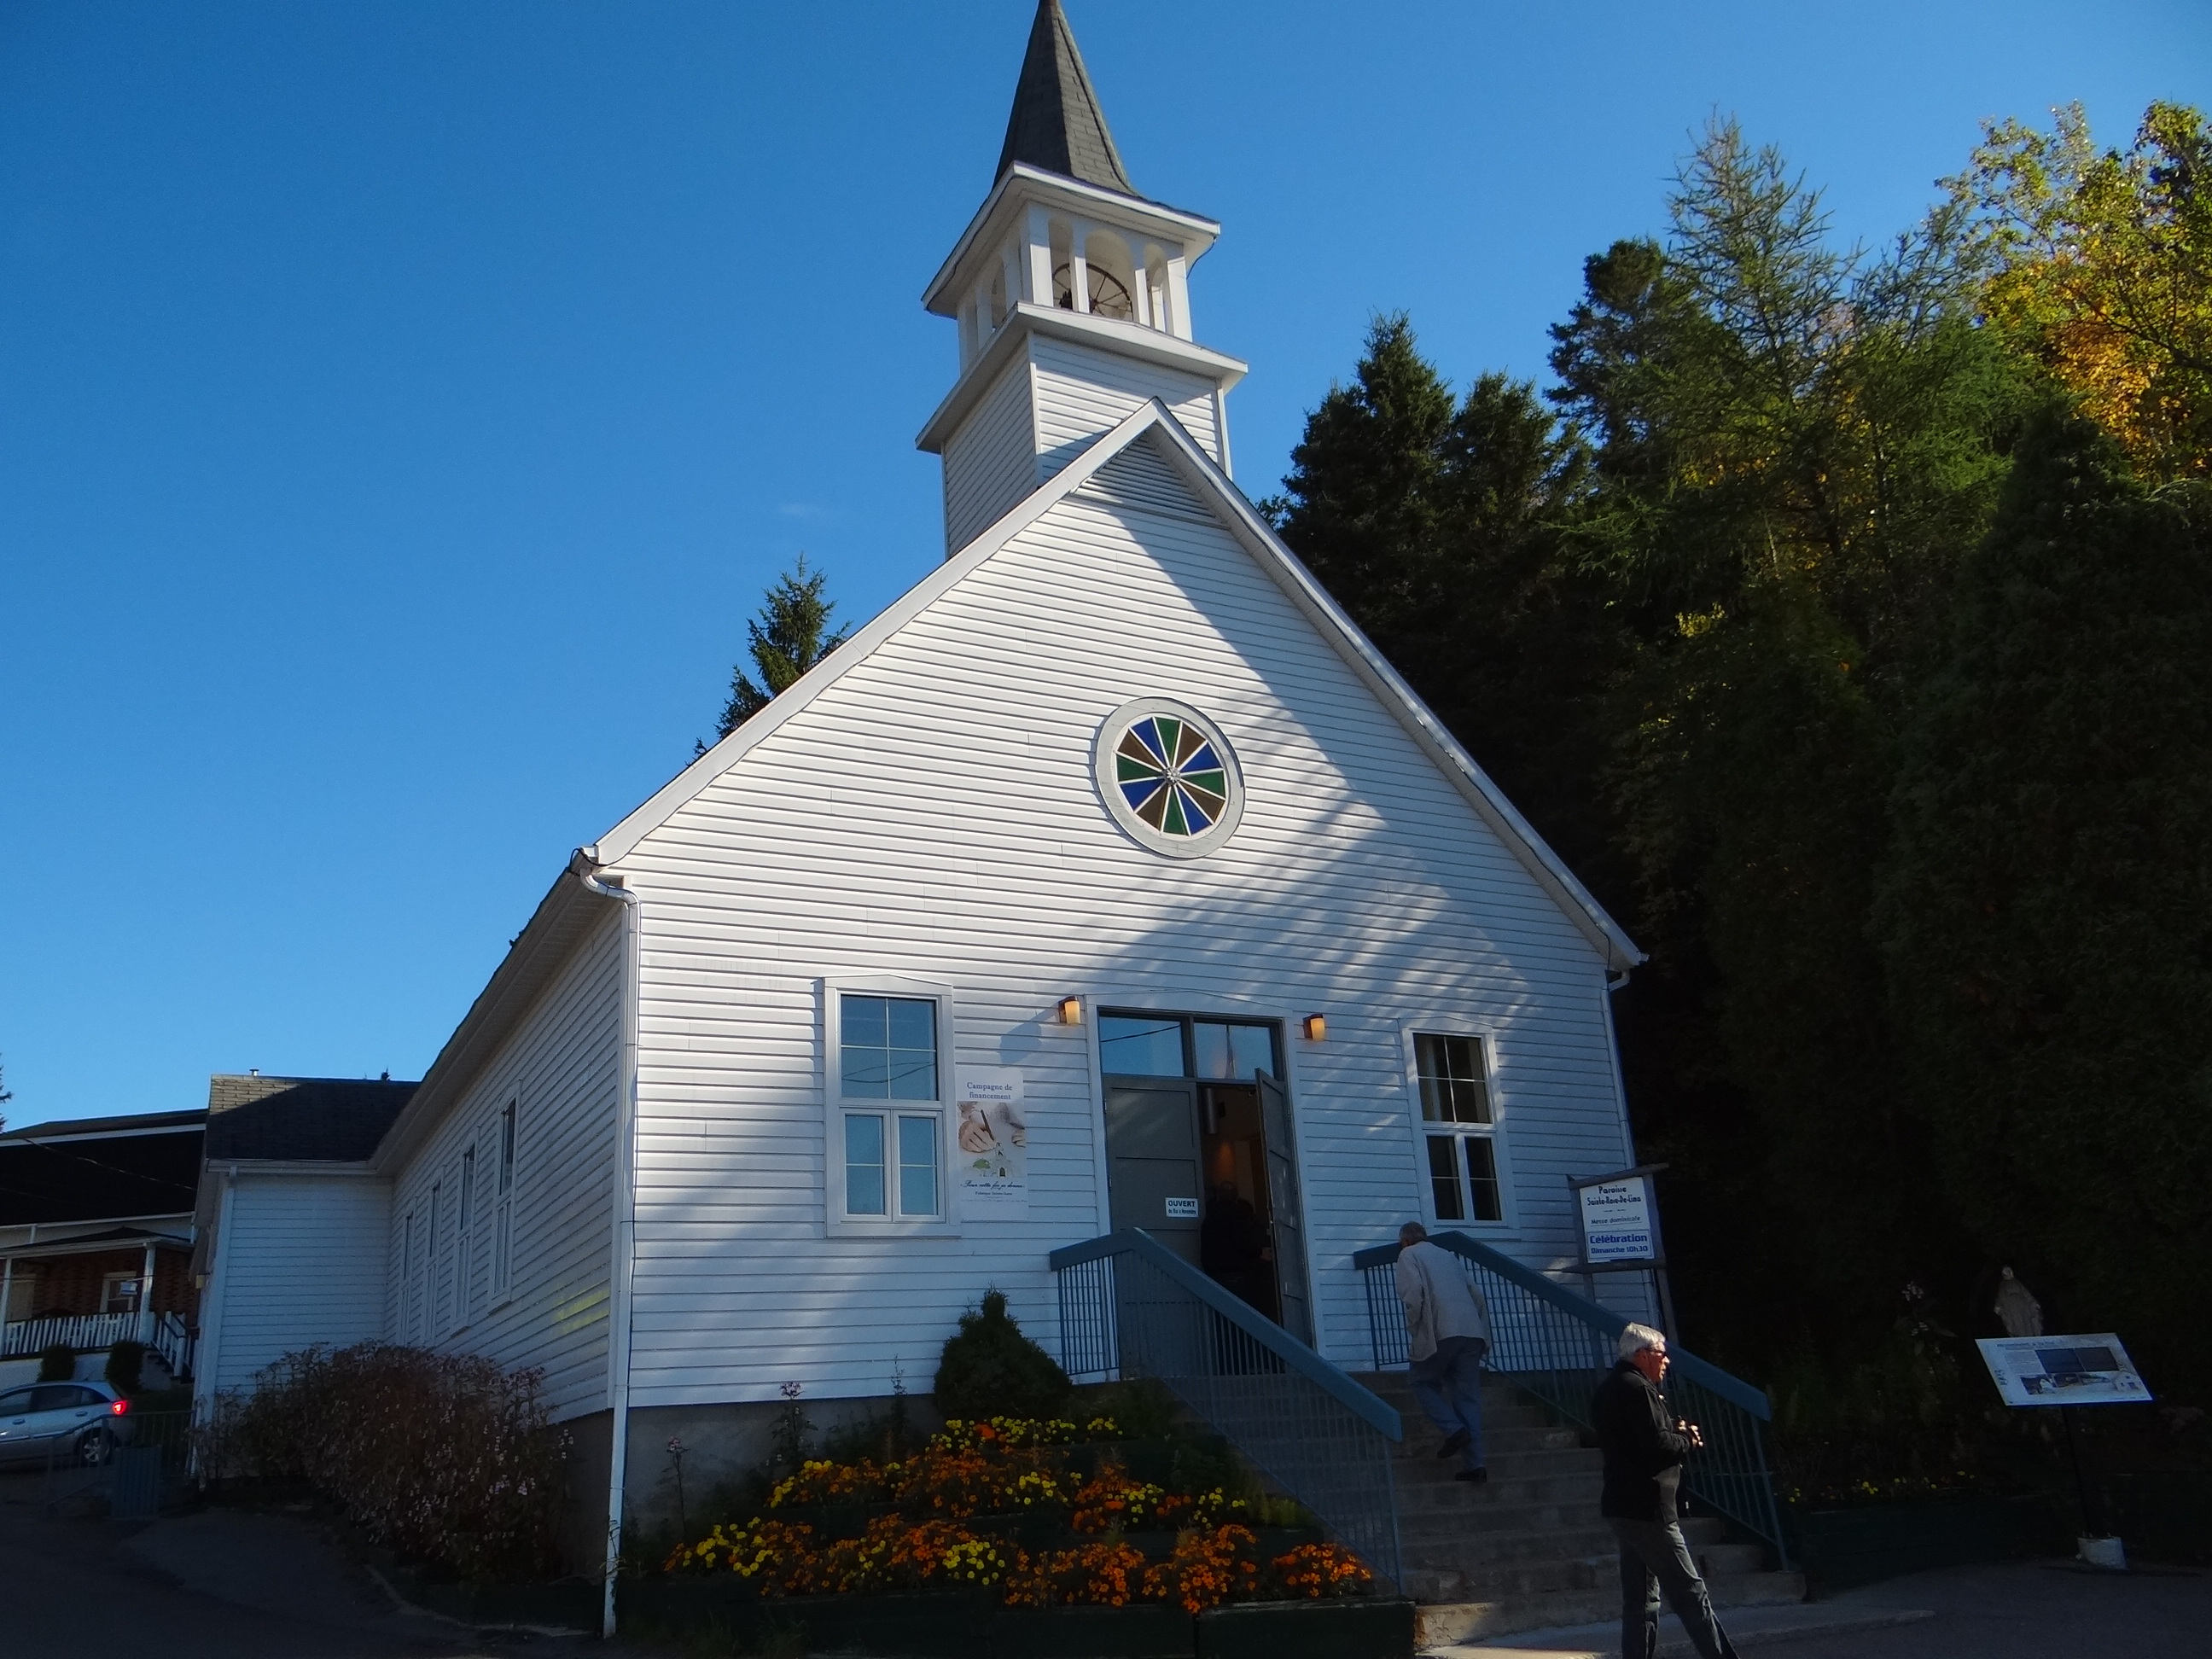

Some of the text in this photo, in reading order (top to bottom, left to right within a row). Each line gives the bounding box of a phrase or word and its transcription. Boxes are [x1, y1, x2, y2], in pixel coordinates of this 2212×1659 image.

[966, 1081, 1003, 1091] Campagne
[969, 1091, 1011, 1100] financement
[1598, 1185, 1627, 1194] Paroisse
[1591, 1234, 1647, 1243] Célébration
[1591, 1246, 1625, 1254] Dimanche
